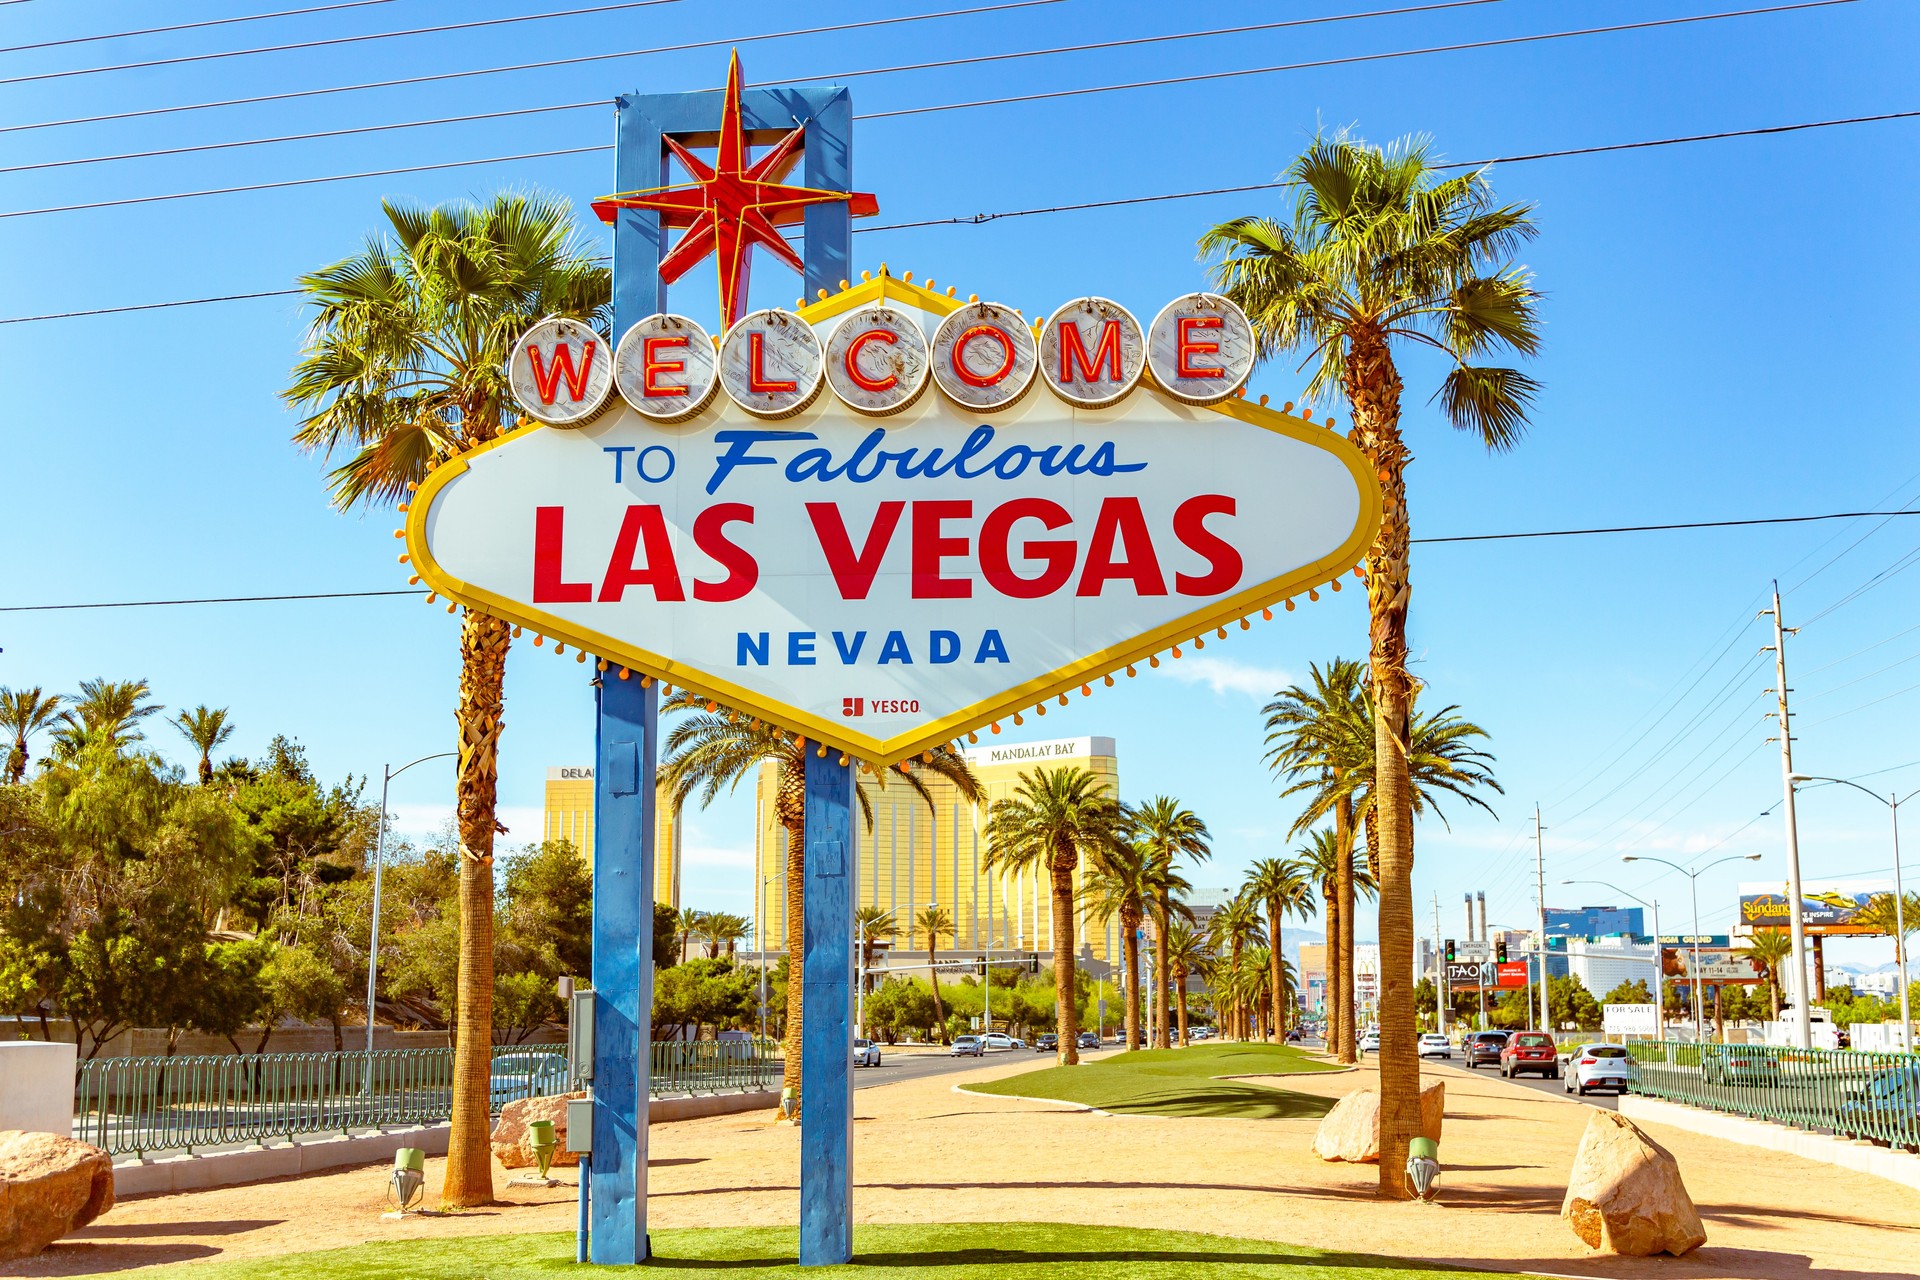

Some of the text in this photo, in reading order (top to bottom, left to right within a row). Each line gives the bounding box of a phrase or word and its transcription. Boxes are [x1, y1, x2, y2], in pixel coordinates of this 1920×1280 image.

[527, 315, 1226, 405] WELCOME
[603, 424, 1148, 496] TO Fabulous
[533, 495, 1244, 604] LAS VEGAS
[736, 629, 1010, 667] NEVADA
[871, 699, 919, 714] YESCO
[991, 742, 1075, 762] MANDALAY BAY
[561, 768, 595, 778] DELA
[1743, 896, 1791, 914] Sundanc
[1658, 936, 1679, 944] MGM
[1447, 964, 1479, 978] TAO
[1606, 1006, 1653, 1014] FOR SALE
